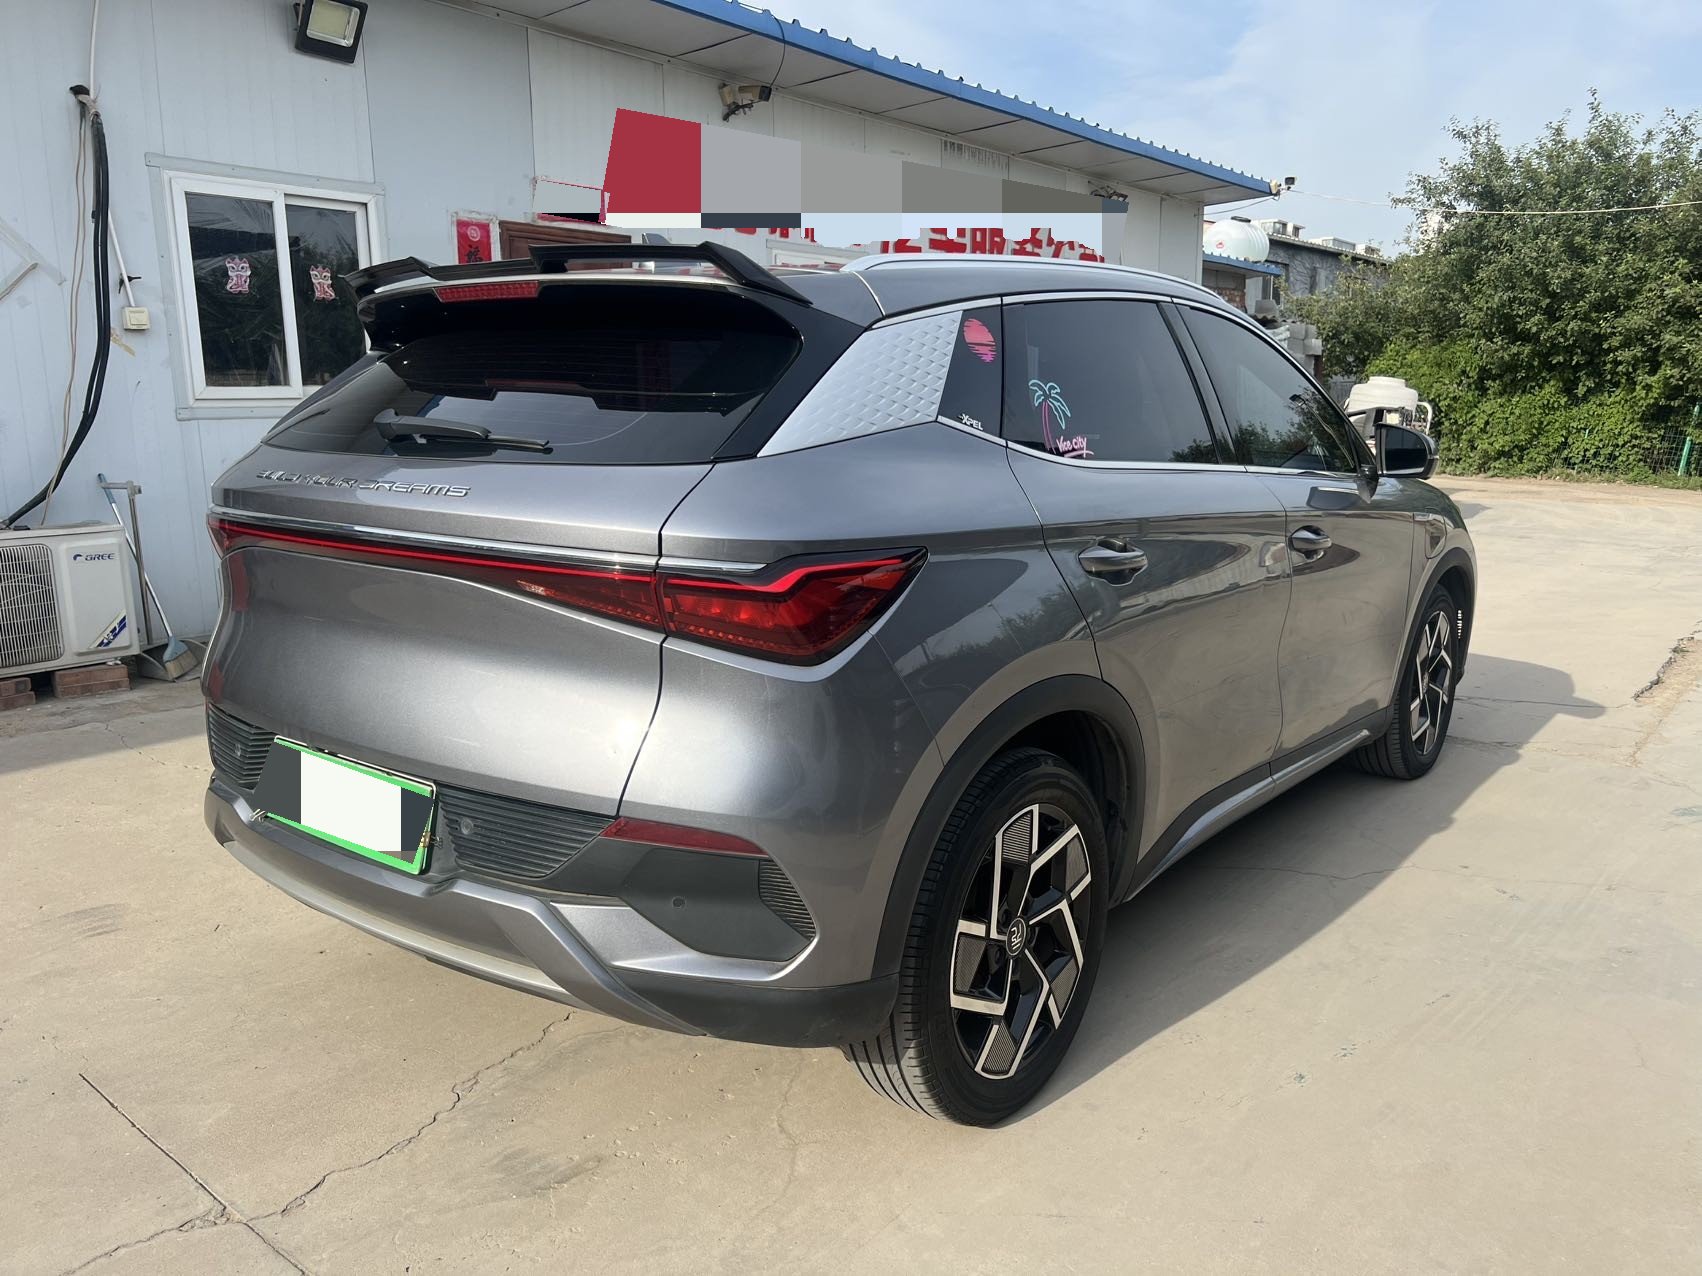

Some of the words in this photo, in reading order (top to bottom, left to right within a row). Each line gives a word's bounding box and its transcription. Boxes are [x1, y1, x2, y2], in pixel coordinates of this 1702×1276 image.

[960, 413, 984, 431] XPEL
[1056, 435, 1073, 453] Vice
[359, 479, 471, 497] DREAMS
[84, 553, 116, 561] GREE
